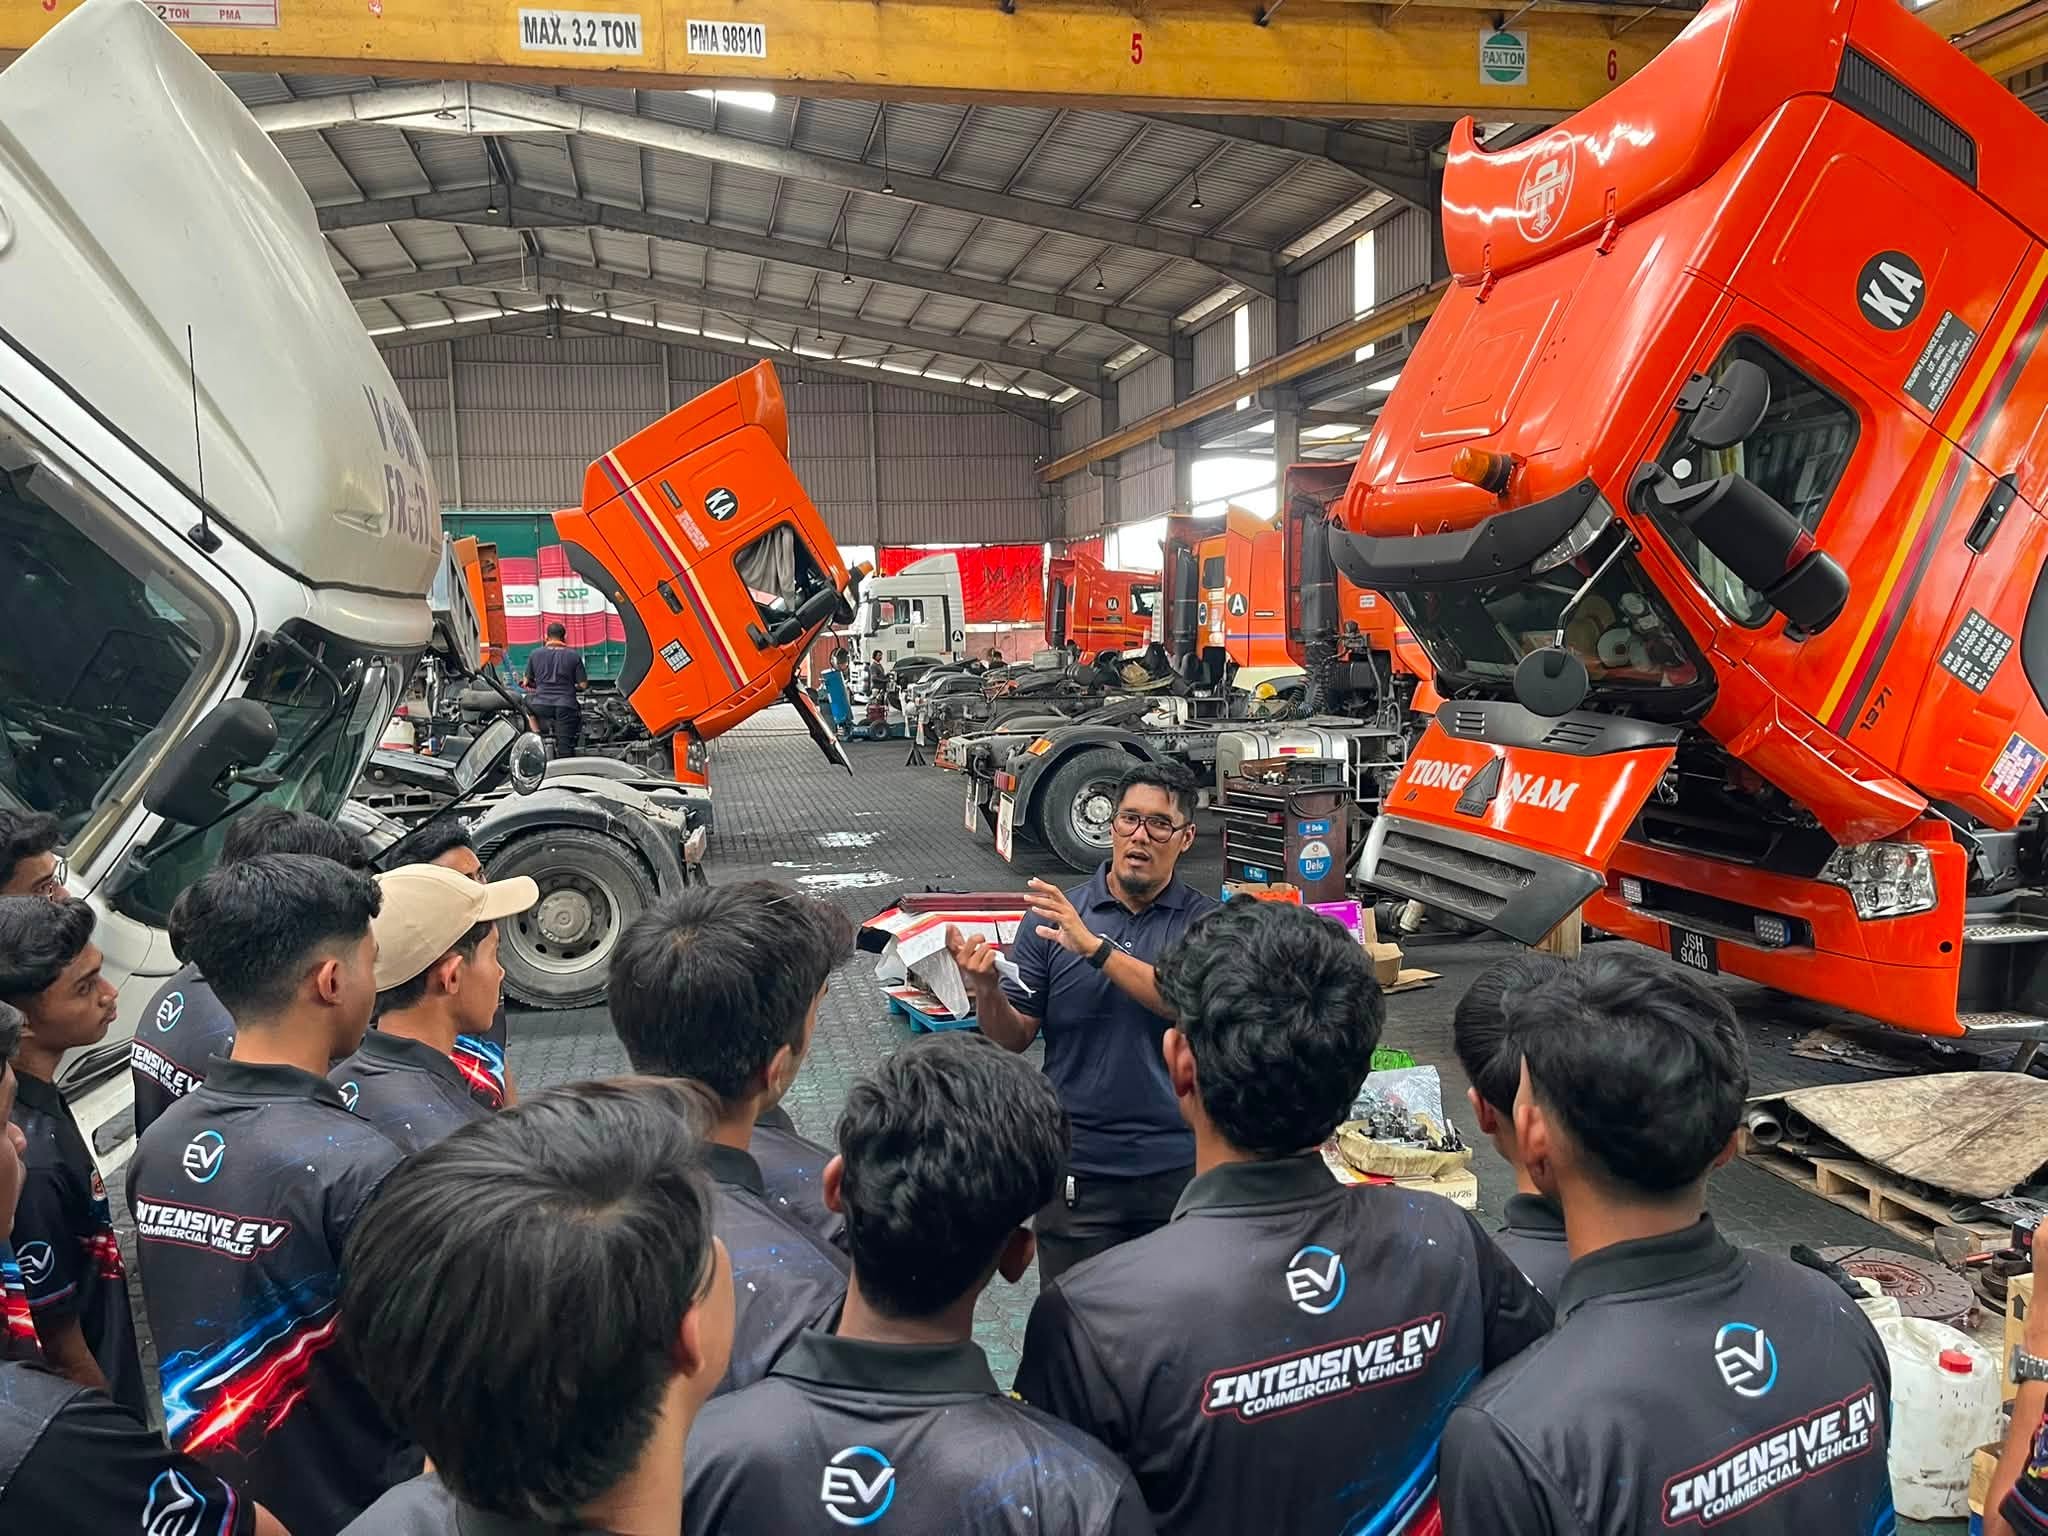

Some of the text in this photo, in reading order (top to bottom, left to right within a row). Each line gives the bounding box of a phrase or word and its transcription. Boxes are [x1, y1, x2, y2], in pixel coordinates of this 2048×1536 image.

[169, 8, 190, 19] TON
[219, 9, 241, 20] PMA
[523, 16, 637, 48] MAX. 3.2 TON
[690, 24, 762, 54] PMA 98910
[1131, 33, 1142, 64] 5
[1483, 51, 1525, 65] PAXTON
[1607, 49, 1617, 81] 6
[1862, 261, 1924, 326] KA
[705, 489, 735, 520] KA
[1107, 598, 1117, 606] KA
[1232, 594, 1245, 614] A
[1967, 612, 1978, 626] KG
[1974, 618, 1986, 632] KG
[1982, 624, 1995, 638] KG
[953, 631, 962, 640] A
[1973, 665, 1981, 673] 1
[1991, 630, 2003, 644] KG
[1982, 671, 1990, 680] 2
[1986, 648, 2005, 673] 12000
[2000, 637, 2012, 651] KG
[1407, 760, 1580, 812] TIONG NAM
[1306, 859, 1324, 872] Delo
[1683, 932, 1704, 953] JSH
[1681, 947, 1708, 970] 9440
[157, 1001, 184, 1023] EV
[173, 1071, 203, 1093] EV
[183, 1145, 226, 1169] EV
[136, 1200, 285, 1245] NTENSIVE EV
[138, 1222, 254, 1256] COMMERCIAL VEHICLE
[1286, 1254, 1341, 1302] EV
[1209, 1320, 1441, 1408] INTENSIVE EV
[1715, 1330, 1764, 1386] EV
[1243, 1353, 1423, 1416] COMMERCIAL VEHICLE
[1670, 1391, 1876, 1518] INTENSIVE EV
[821, 1466, 896, 1503] EV
[1703, 1429, 1869, 1520] COMMERCIAL VEHICLE
